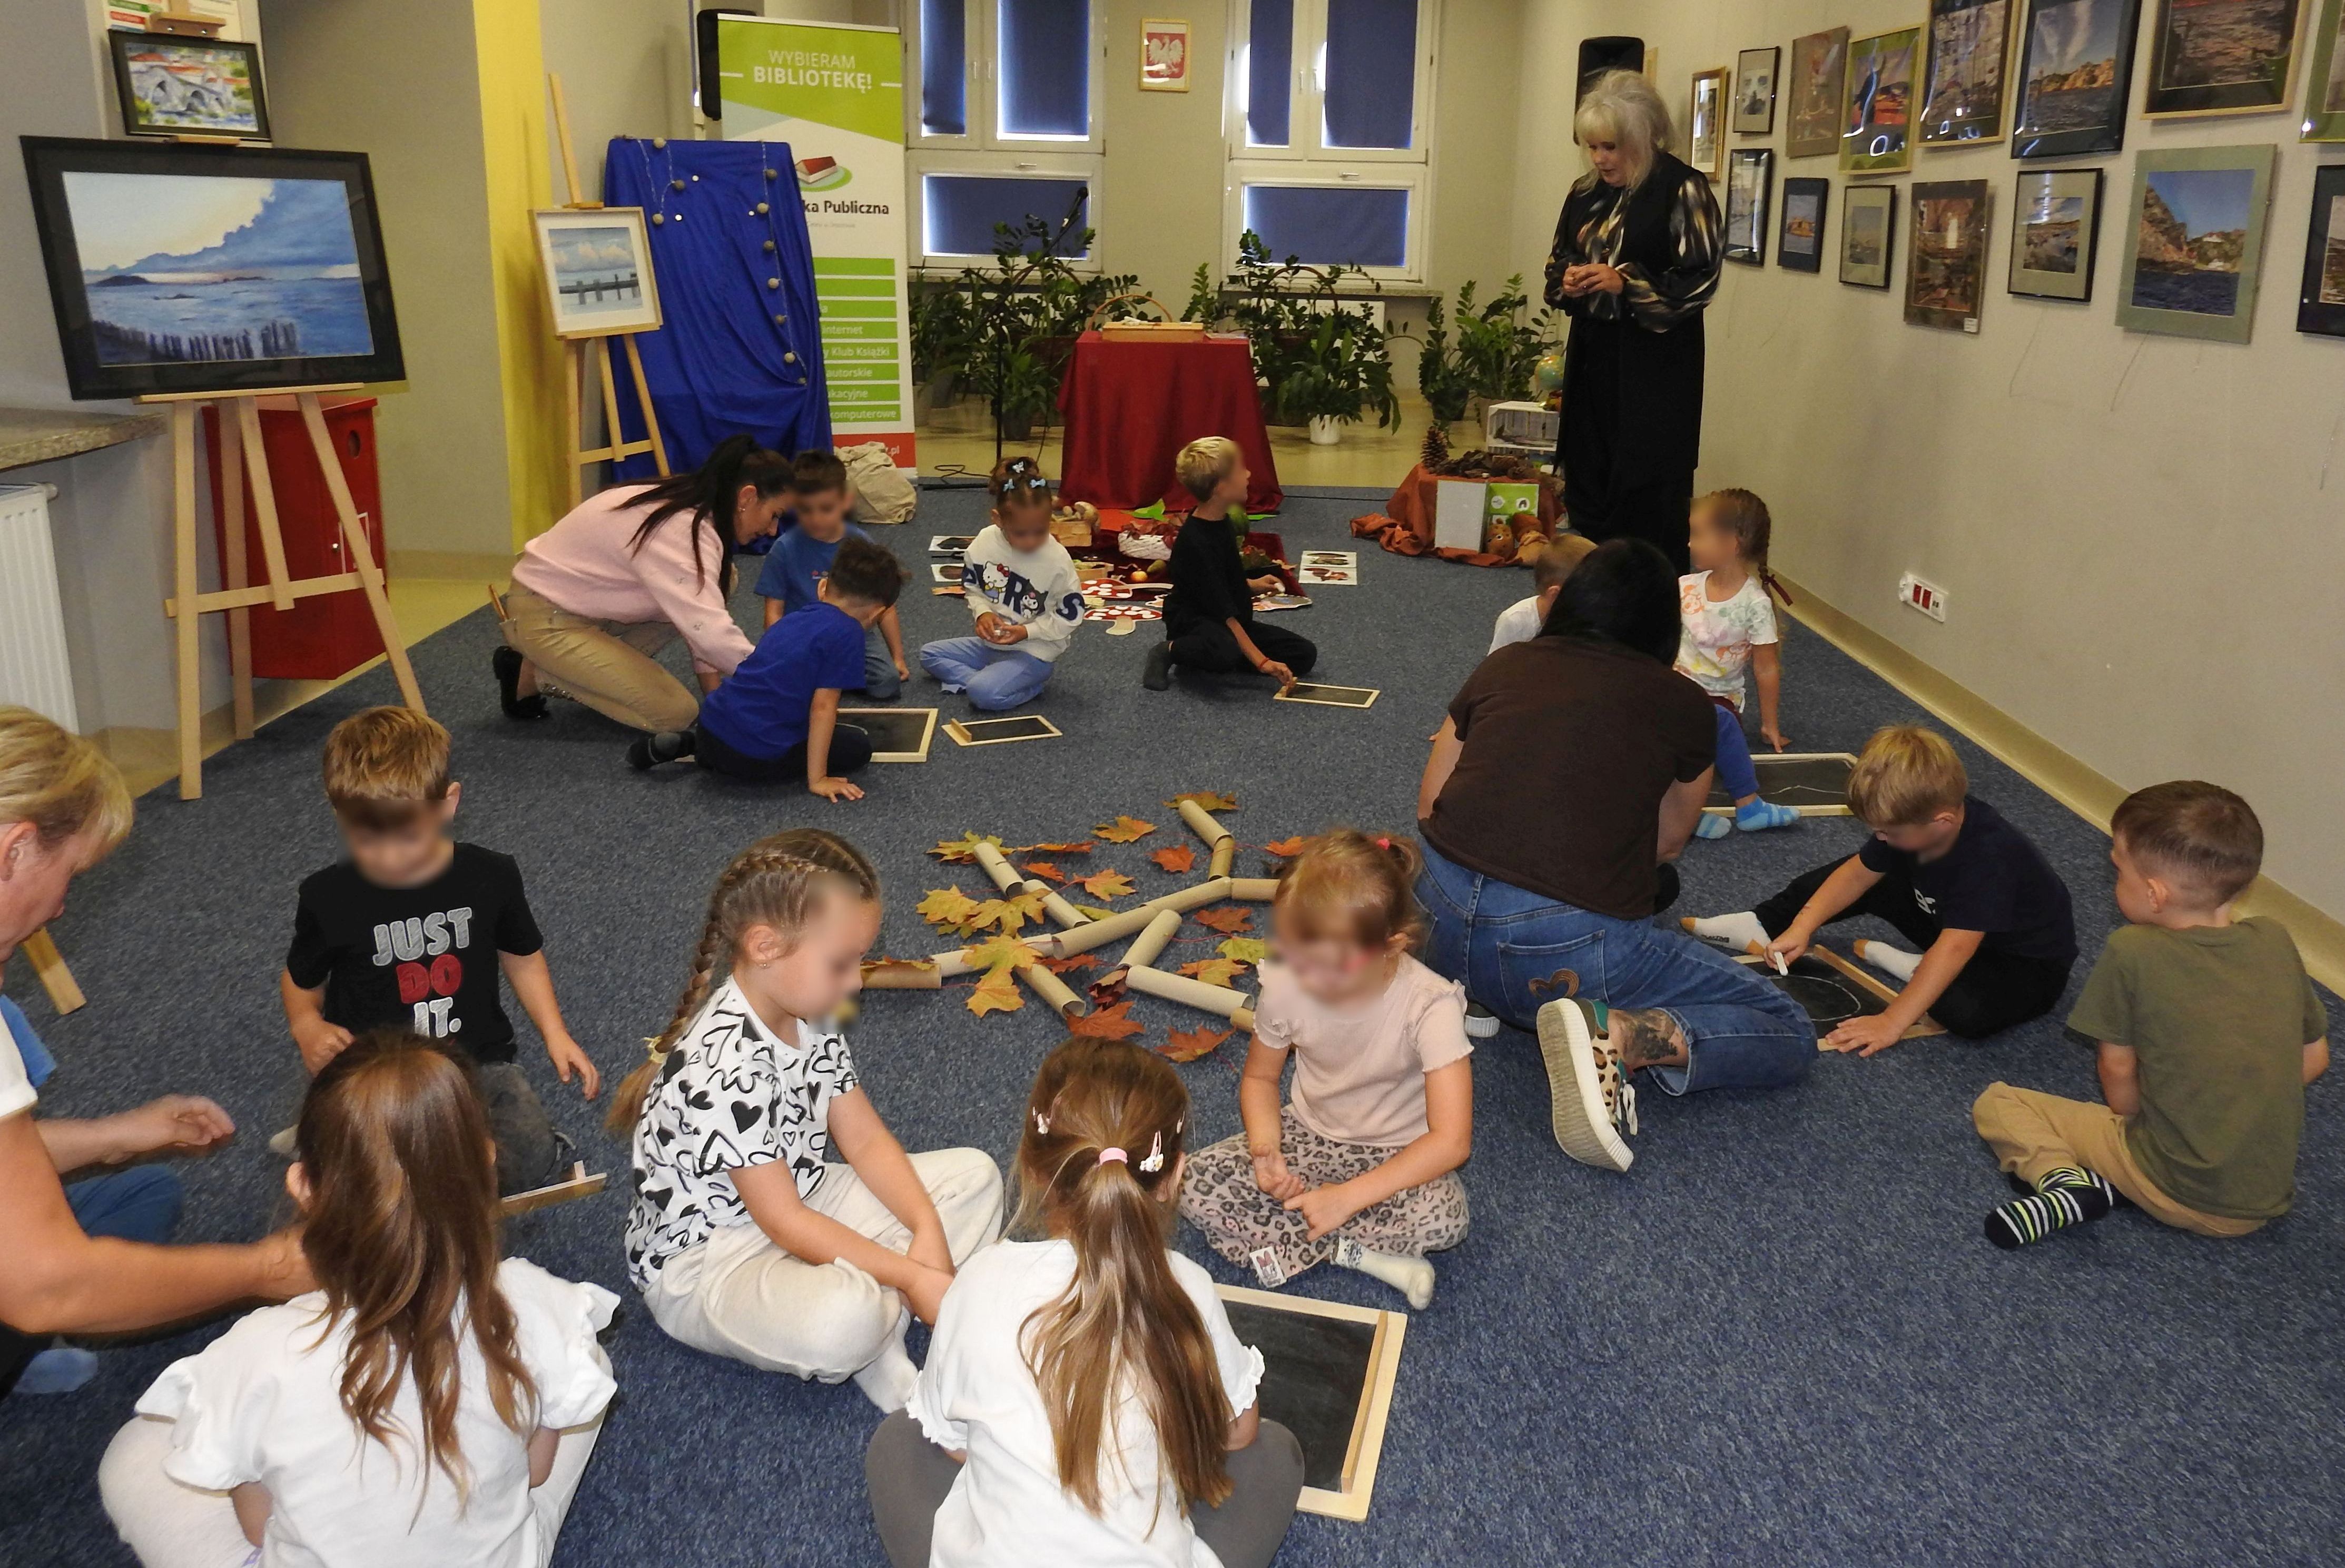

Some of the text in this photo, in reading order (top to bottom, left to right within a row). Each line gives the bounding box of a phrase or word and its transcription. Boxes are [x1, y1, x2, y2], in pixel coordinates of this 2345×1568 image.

[768, 50, 856, 69] WYBIERAM
[753, 66, 872, 93] BIBLIOTEKĘ!
[824, 200, 889, 214] Publiczna
[832, 347, 854, 357] Klub
[856, 347, 890, 358] Książki
[372, 906, 472, 967] JUST
[396, 954, 462, 1004] DO
[413, 997, 462, 1038] IT.
